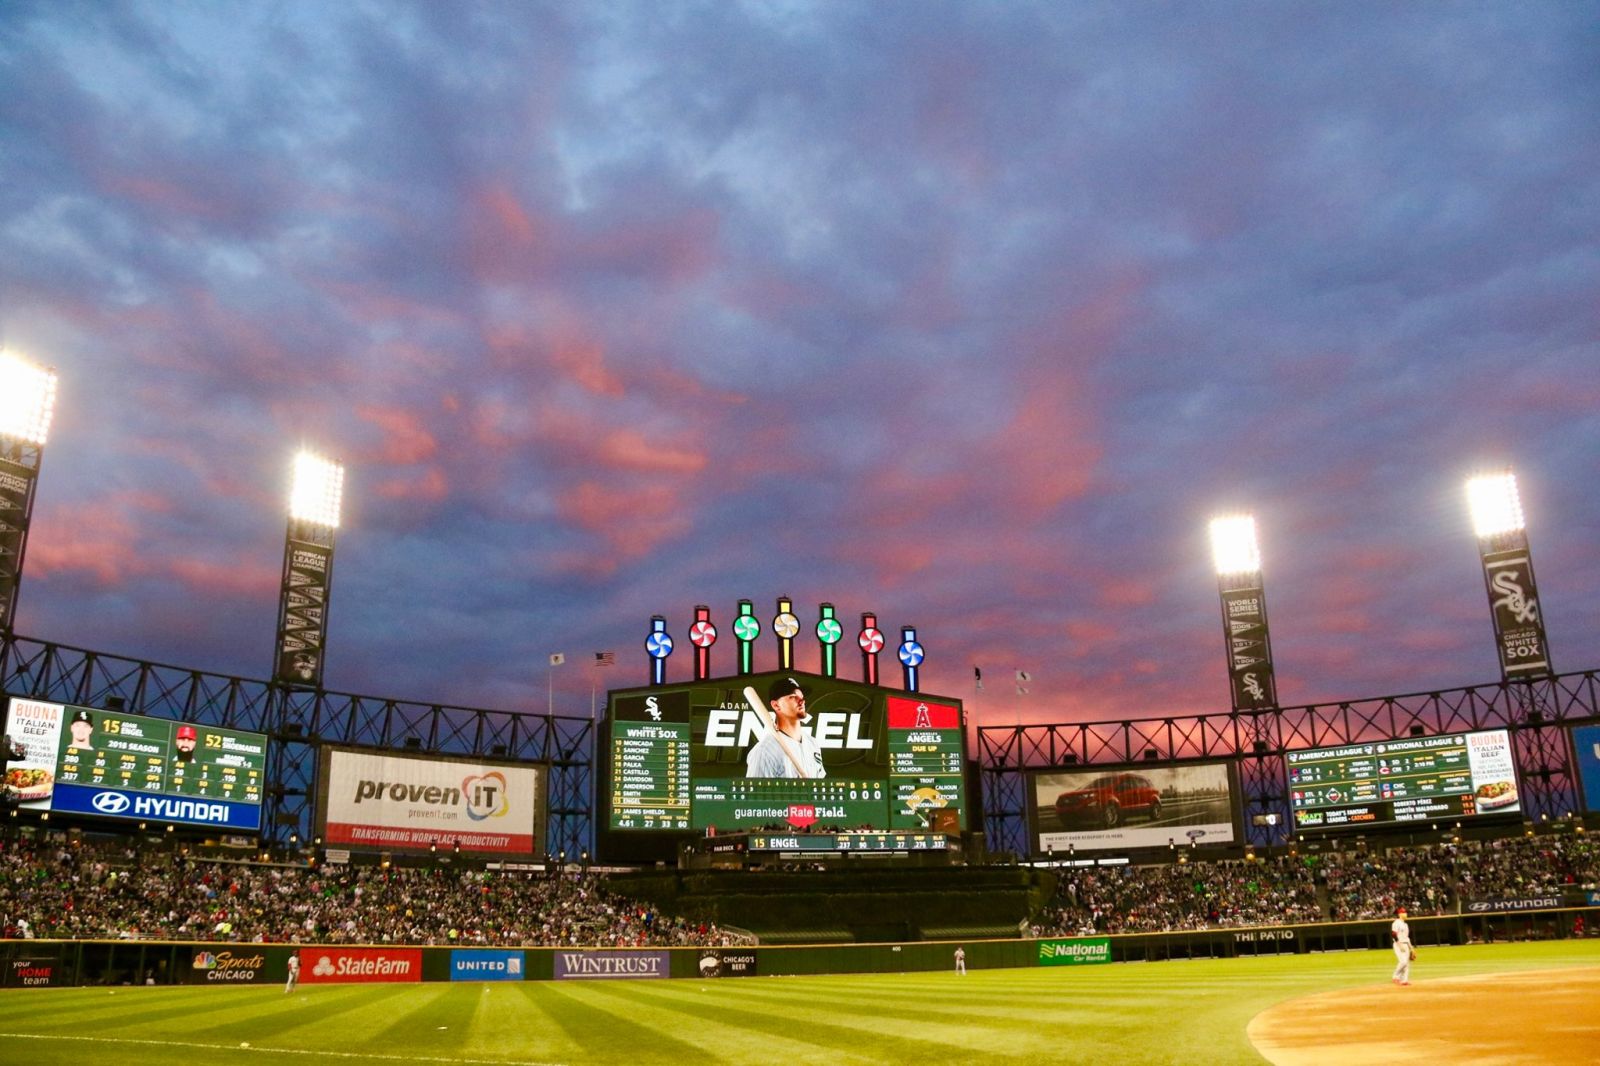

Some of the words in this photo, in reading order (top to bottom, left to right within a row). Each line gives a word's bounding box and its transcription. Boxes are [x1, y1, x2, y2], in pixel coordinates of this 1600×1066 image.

[293, 555, 325, 568] LEAGUE
[1228, 599, 1258, 607] WORLD
[1229, 604, 1258, 613] SERIES
[1504, 631, 1537, 641] CHICAGO
[1505, 637, 1538, 648] WHITE
[1507, 645, 1540, 659] SOX
[16, 703, 57, 720] BUONA
[720, 702, 749, 710] ADAM
[16, 718, 55, 729] ITALIAN
[103, 719, 120, 733] 15
[23, 727, 48, 736] BEEF
[121, 728, 144, 737] ENGEL
[627, 729, 656, 738] WHITE
[704, 710, 873, 749] ENEL
[205, 734, 222, 748] 52
[907, 735, 942, 743] ANGELS
[1388, 741, 1423, 751] NATIONAL
[1425, 738, 1453, 747] LEAGUE
[1470, 734, 1505, 747] BUONA
[128, 743, 159, 753] SEASON
[1299, 750, 1335, 760] AMERICAN
[1336, 748, 1363, 757] LEAGUE
[123, 778, 129, 786] 5
[354, 779, 460, 805] proven
[474, 786, 497, 808] IT
[849, 790, 857, 800] 0
[862, 790, 869, 800] 0
[874, 790, 881, 800] 0
[134, 797, 229, 822] HYUNDAI
[734, 807, 788, 819] guaranteed
[790, 806, 813, 817] Rate
[815, 806, 847, 817] Field.
[1416, 804, 1449, 812] MALDONADO
[351, 828, 410, 842] TRANSFORMING
[412, 832, 456, 844] WORKPLACE
[754, 838, 765, 848] 15
[770, 838, 800, 848] ENGEL
[1495, 898, 1558, 909] HYUNDAI
[1055, 943, 1109, 956] National
[215, 952, 264, 972] Sports
[457, 961, 505, 970] UNITED
[562, 954, 660, 973] WINTRUST
[18, 967, 52, 977] HOME
[207, 970, 255, 980] CHICAGO
[23, 976, 49, 985] team
